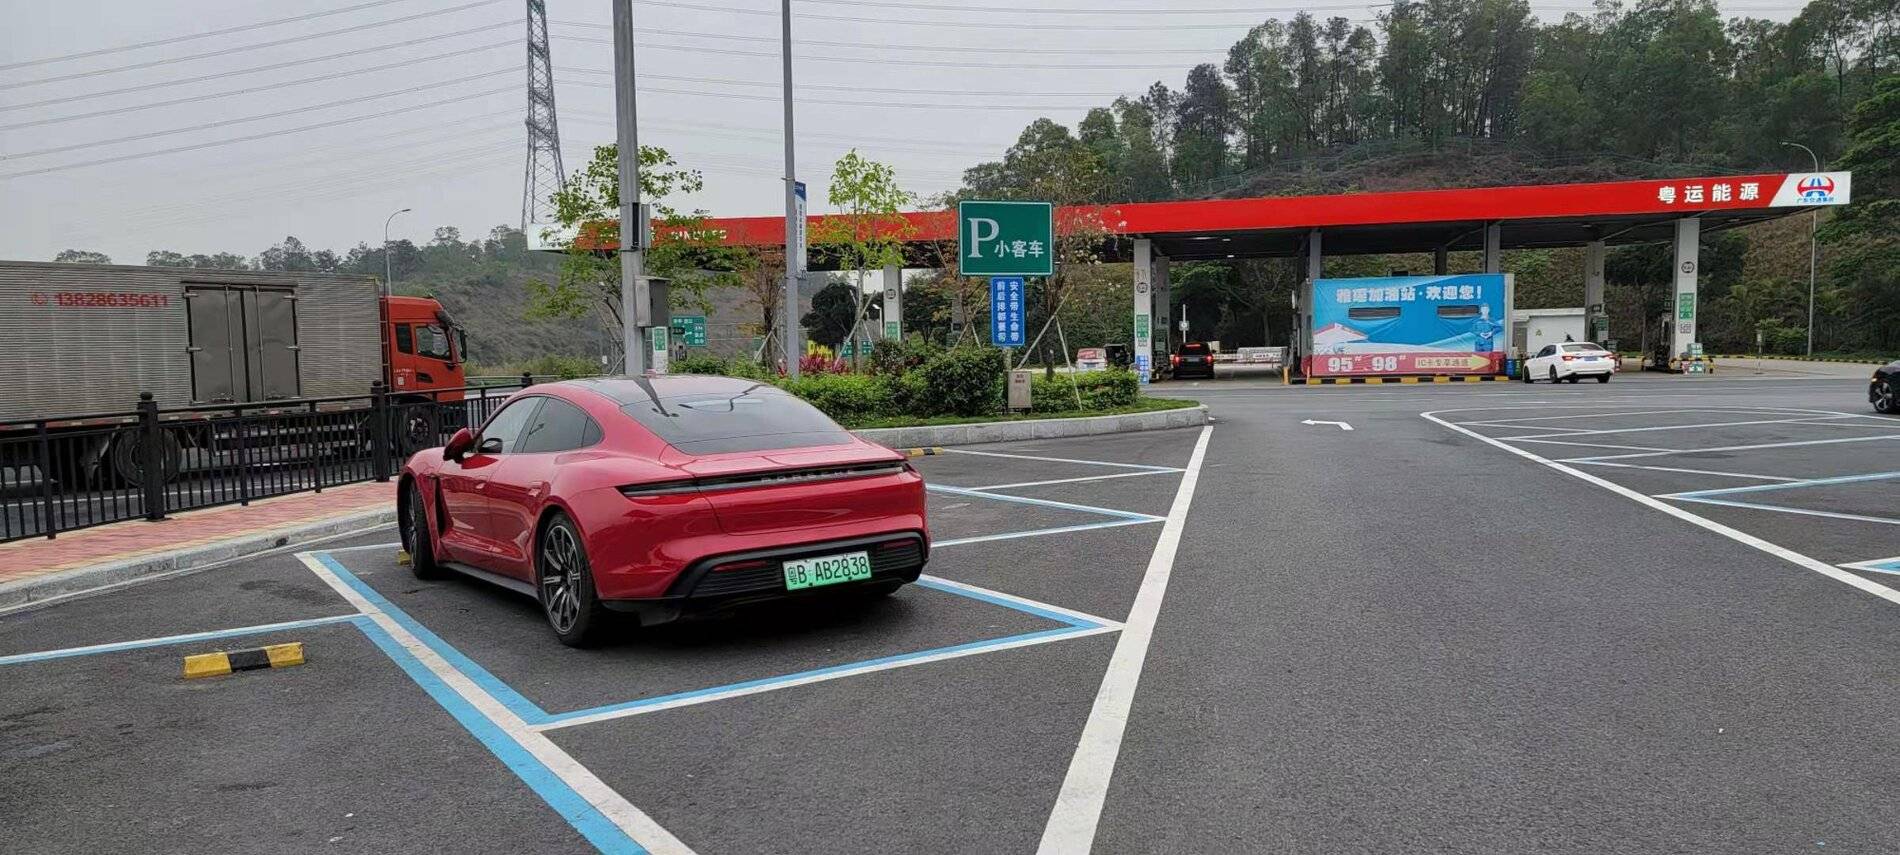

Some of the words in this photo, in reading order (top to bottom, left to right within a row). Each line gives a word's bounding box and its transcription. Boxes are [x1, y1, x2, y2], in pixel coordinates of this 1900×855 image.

[1657, 183, 1760, 205] 粤运能源
[967, 217, 1000, 259] P
[994, 239, 1045, 259] 小客车
[55, 292, 168, 308] 13828635611
[1009, 281, 1020, 342] 安全带生命带
